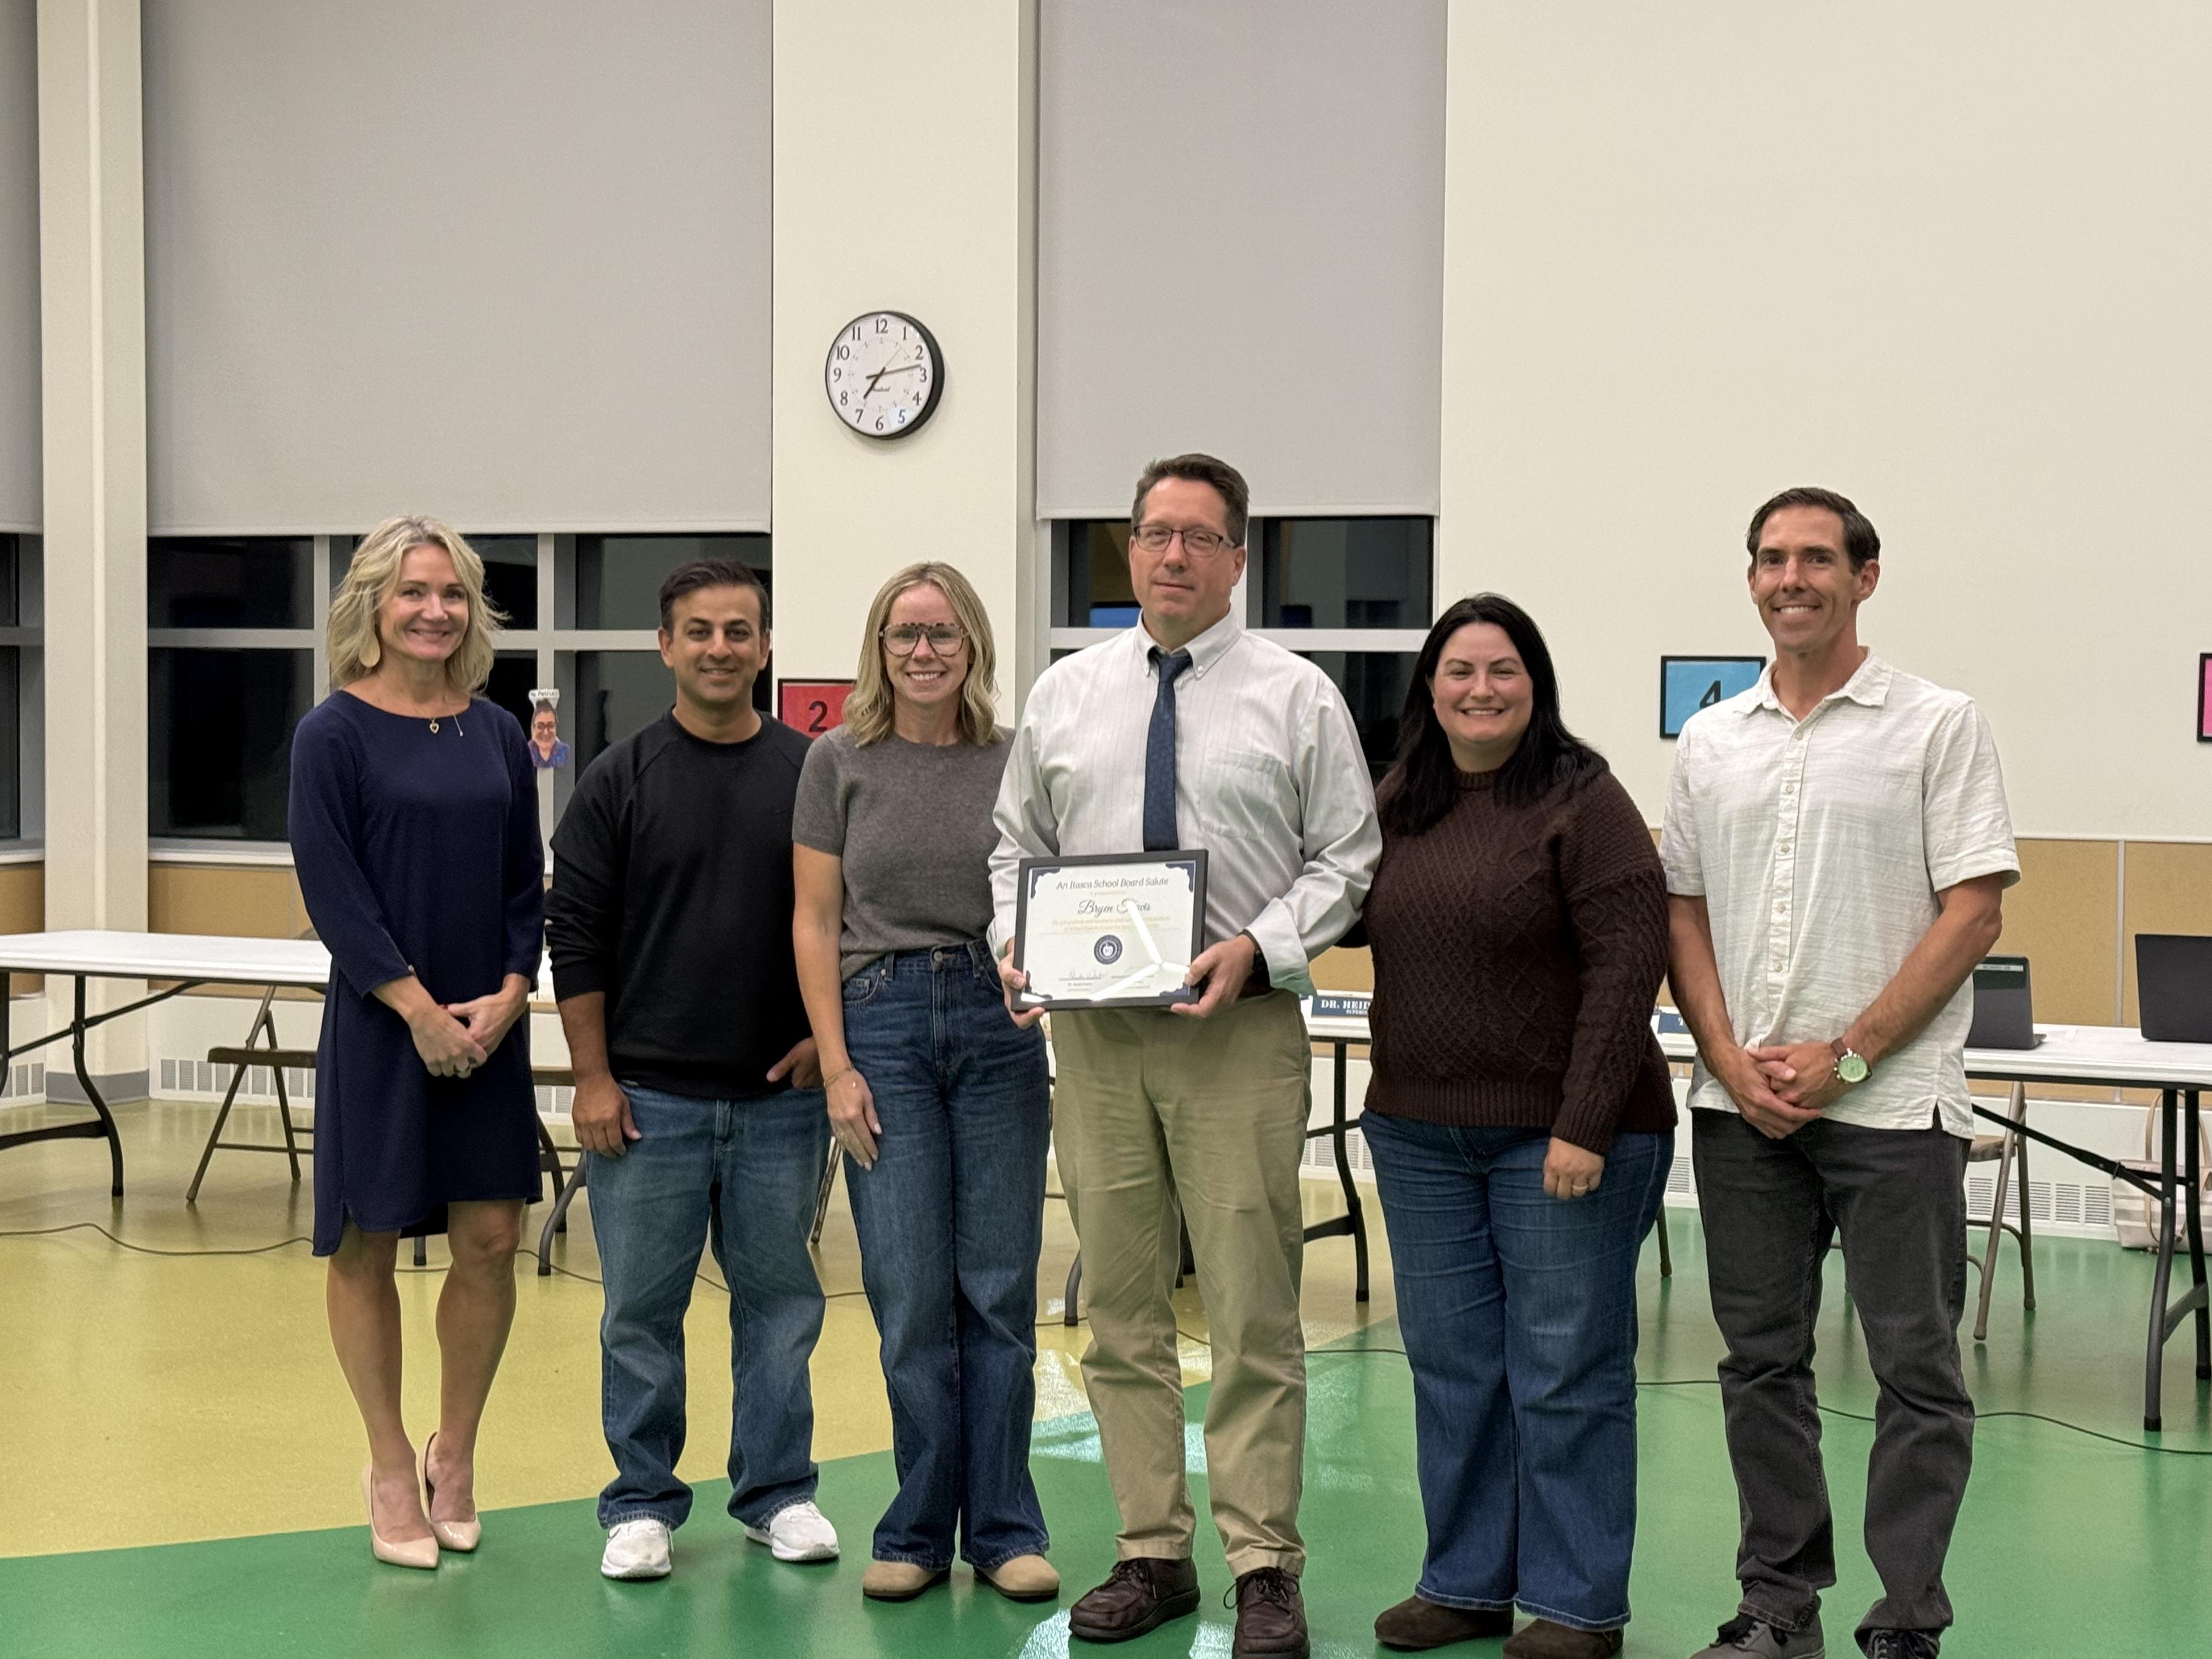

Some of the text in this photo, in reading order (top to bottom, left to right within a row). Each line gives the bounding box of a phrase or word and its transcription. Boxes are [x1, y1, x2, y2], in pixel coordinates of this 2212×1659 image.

[851, 326, 861, 341] 11
[875, 318, 888, 334] 12
[902, 326, 907, 341] 1
[836, 345, 850, 360] 10
[915, 345, 924, 360] 2
[833, 367, 842, 382] 9
[919, 366, 927, 382] 3
[840, 390, 848, 405] 8
[912, 391, 922, 405] 4
[855, 409, 864, 424] 7
[875, 415, 884, 431] 6
[898, 409, 906, 424] 5
[1700, 680, 1721, 709] 4
[809, 701, 827, 732] 2
[1056, 876, 1169, 890] An Itasca School Board Salute
[1321, 999, 1340, 1009] DR.
